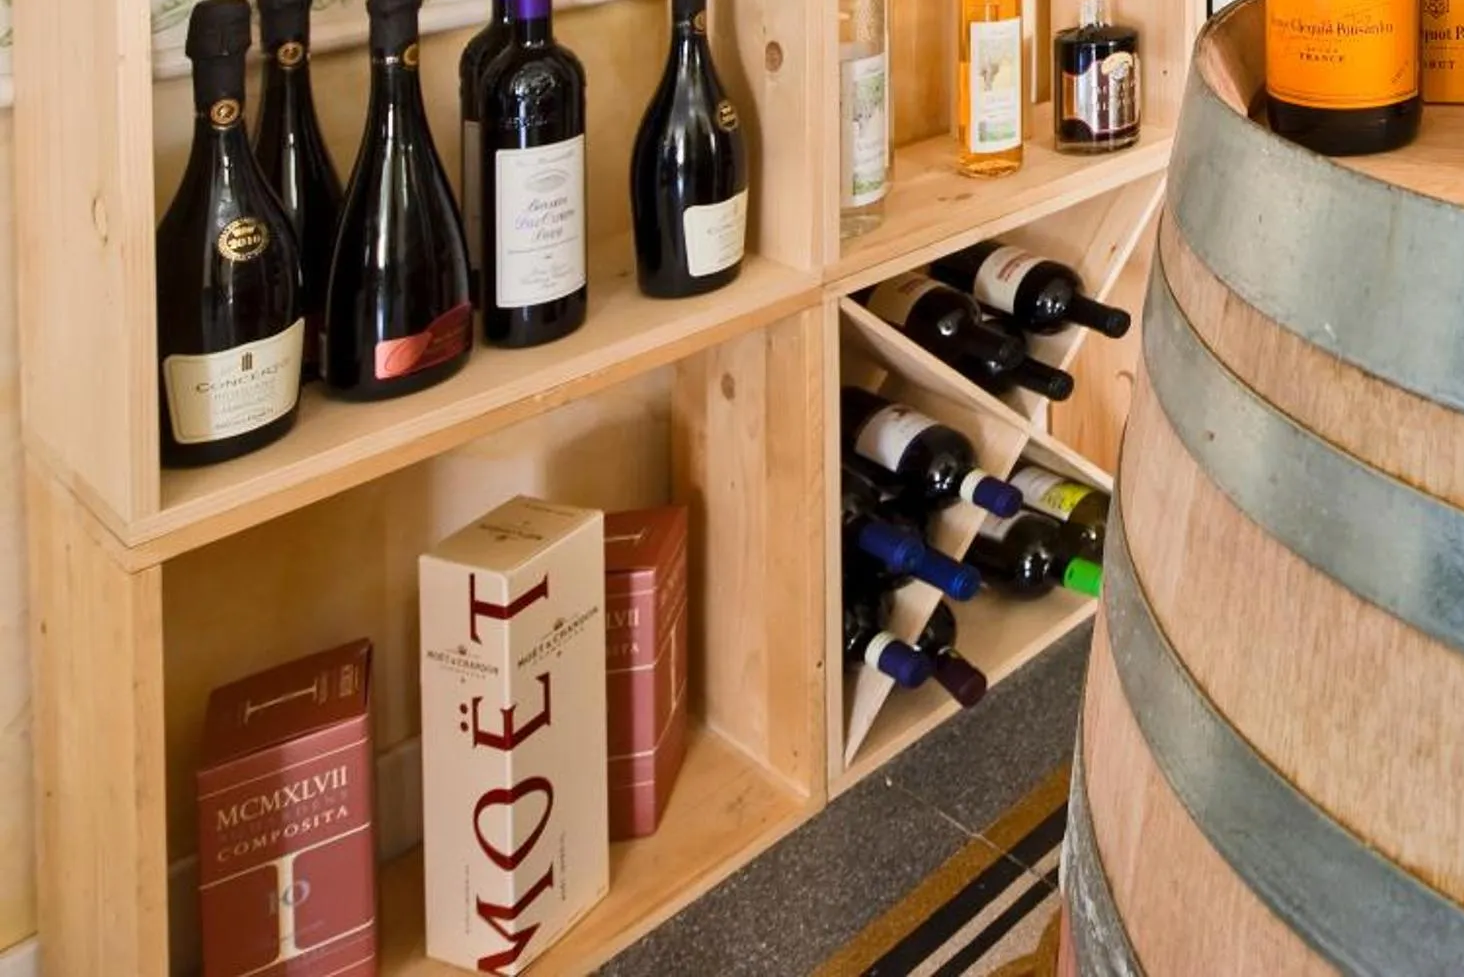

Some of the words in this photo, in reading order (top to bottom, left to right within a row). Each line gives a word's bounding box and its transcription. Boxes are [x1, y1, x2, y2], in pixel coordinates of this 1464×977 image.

[216, 765, 348, 831] MCMXLVII
[460, 573, 554, 977] MOËT
[217, 804, 349, 863] COMPOSITA
